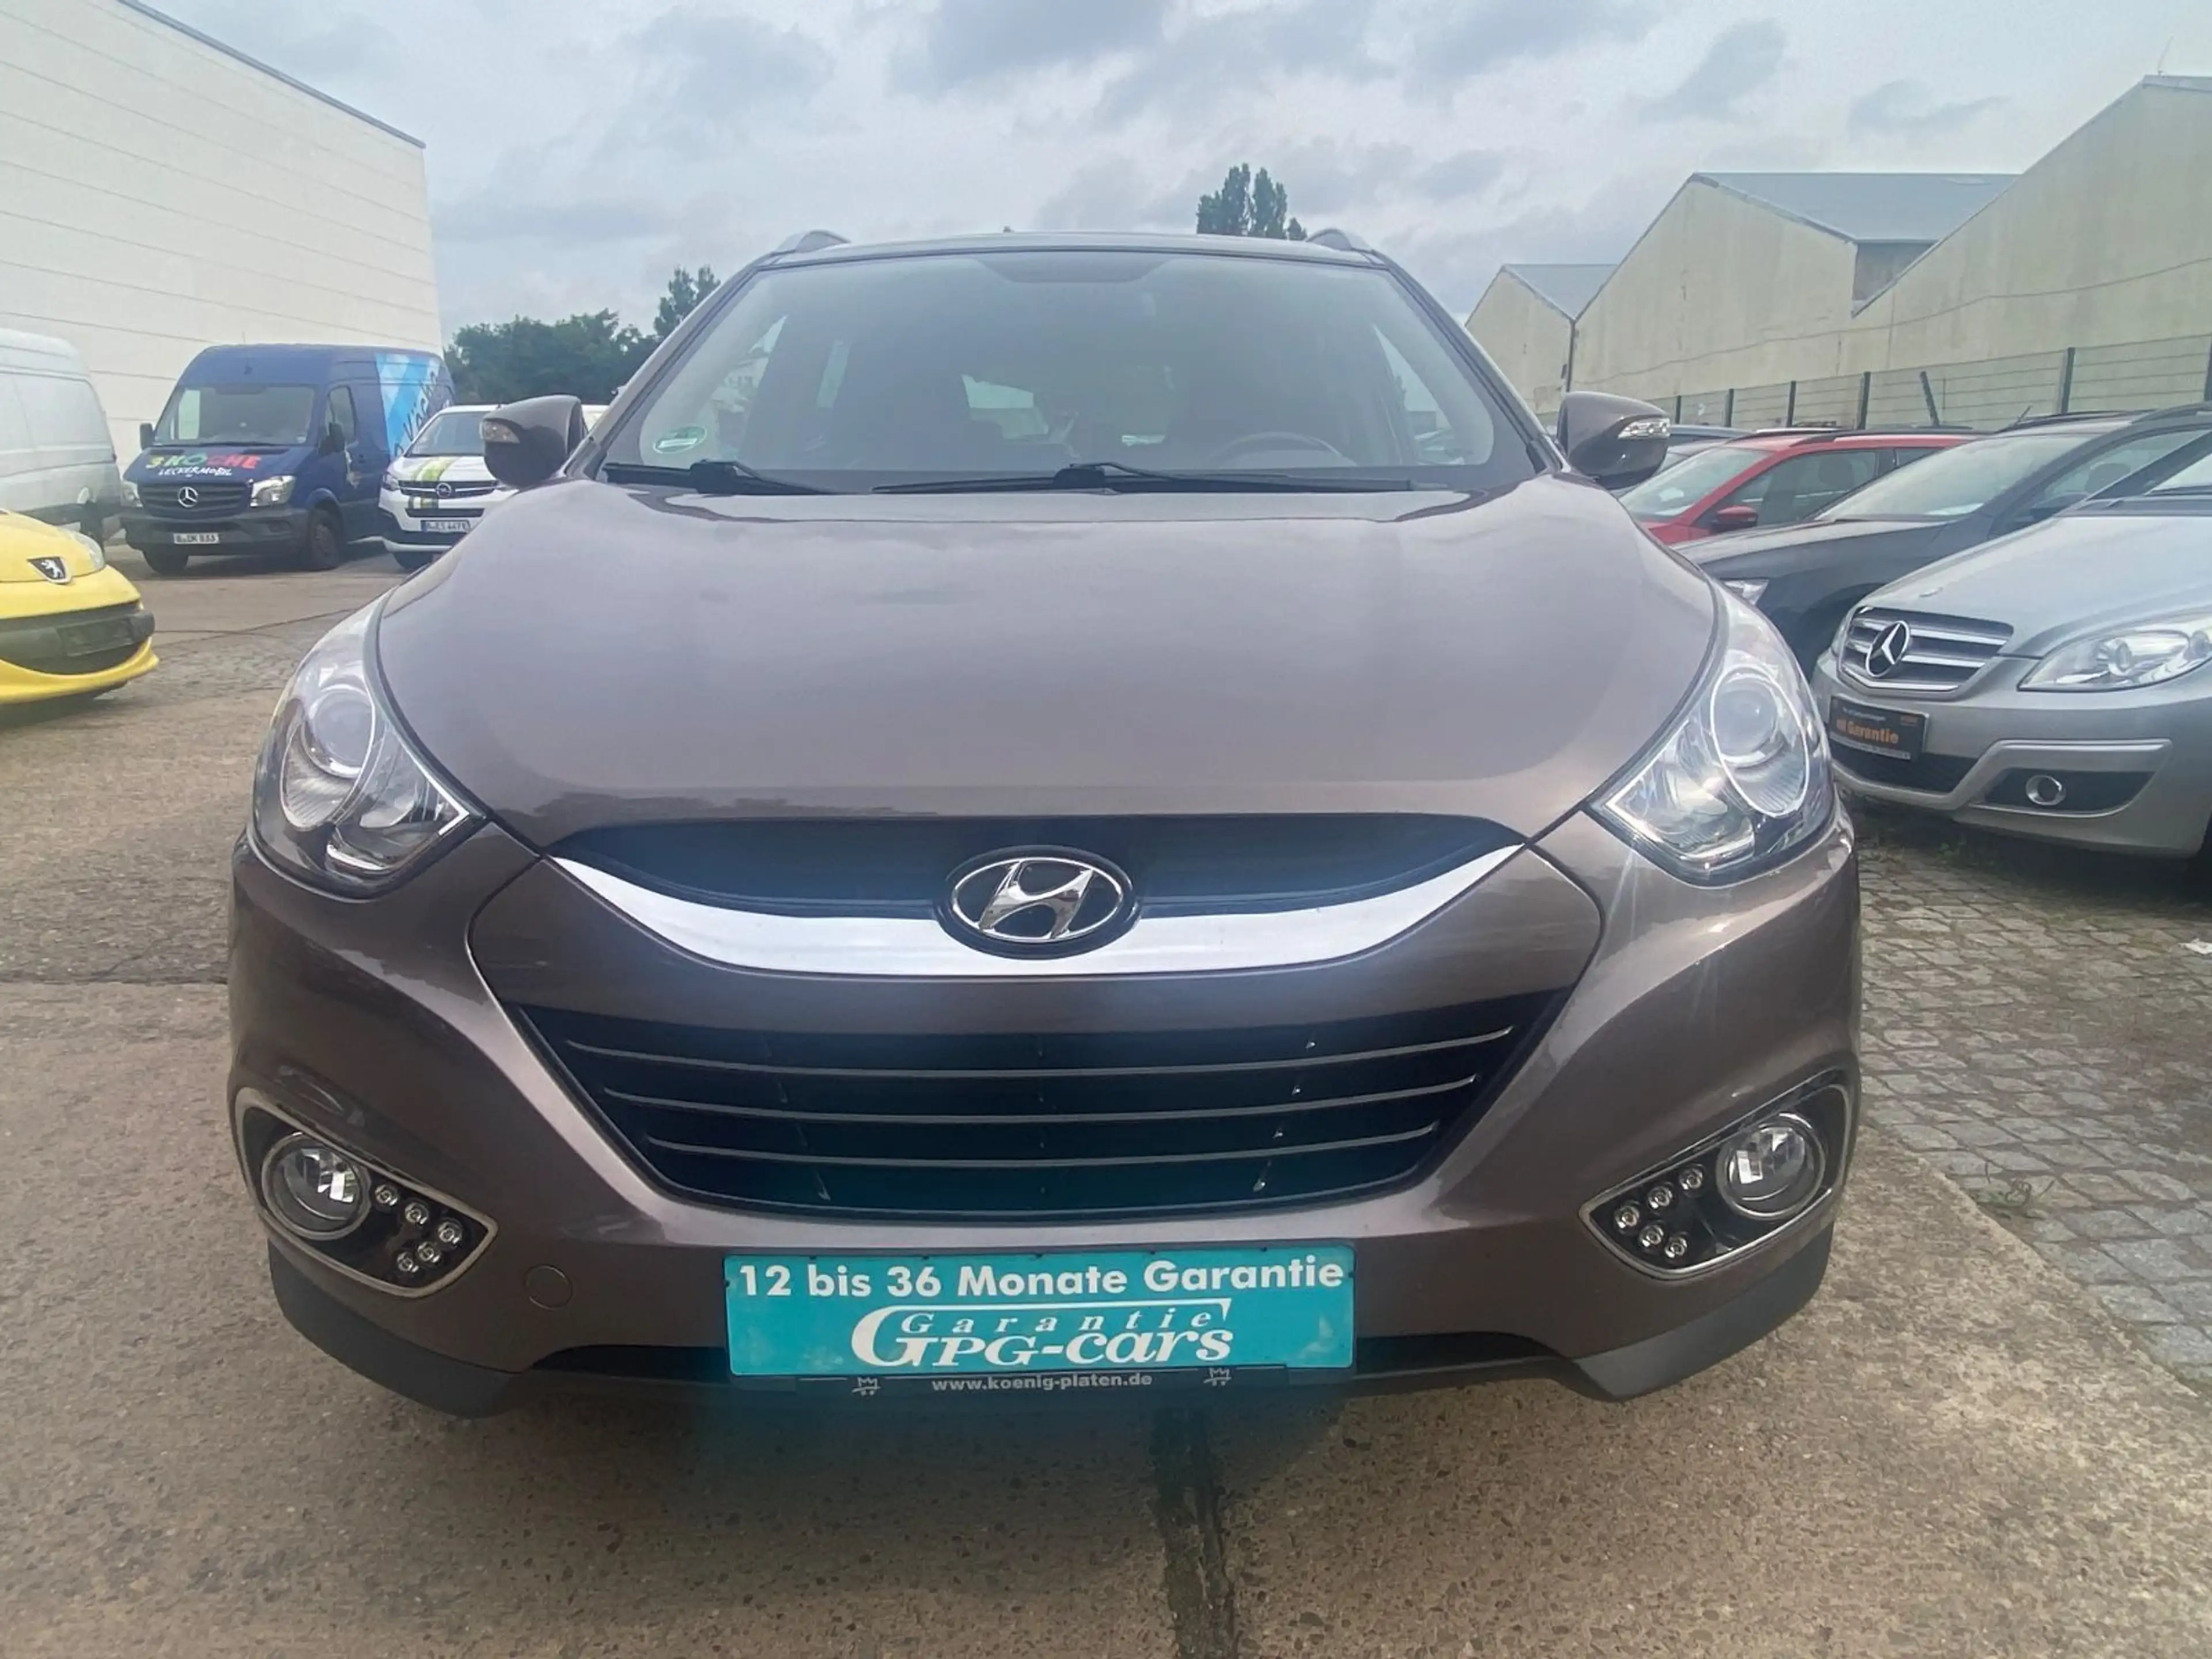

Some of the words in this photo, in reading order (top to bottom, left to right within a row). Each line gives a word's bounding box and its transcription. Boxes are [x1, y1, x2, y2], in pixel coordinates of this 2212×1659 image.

[740, 1265, 791, 1296] 12
[808, 1264, 872, 1296] bis
[887, 1266, 942, 1297] 36
[957, 1265, 1127, 1297] Monate
[1143, 1254, 1344, 1292] Garantie
[851, 1298, 1233, 1367] GPG-cars
[900, 1308, 1212, 1334] Garantie
[931, 1373, 1153, 1391] www.koenig-platen.de
